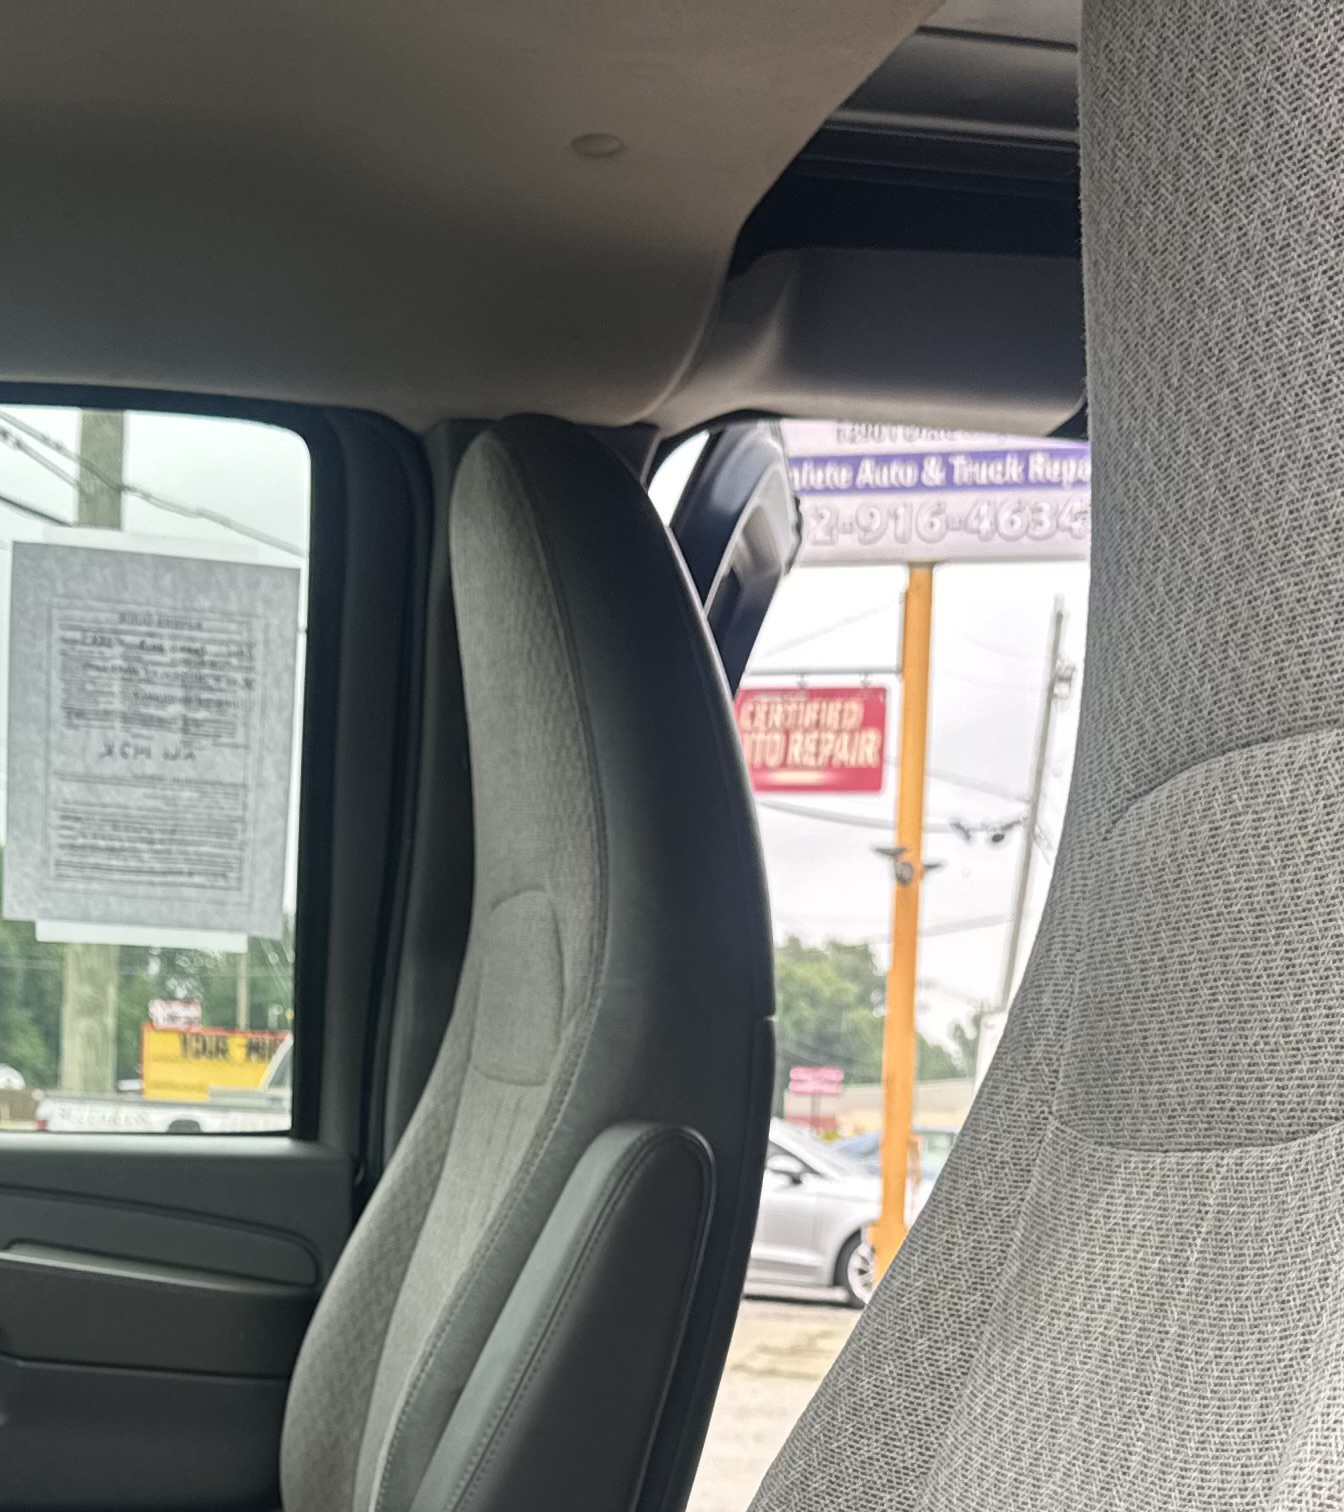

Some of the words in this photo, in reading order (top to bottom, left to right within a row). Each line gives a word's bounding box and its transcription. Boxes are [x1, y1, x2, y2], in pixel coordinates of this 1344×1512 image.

[855, 456, 919, 488] Auto
[921, 455, 947, 487] &
[949, 452, 1024, 485] Truck
[739, 701, 865, 732] CERTIFIED
[786, 727, 883, 768] REPAIR
